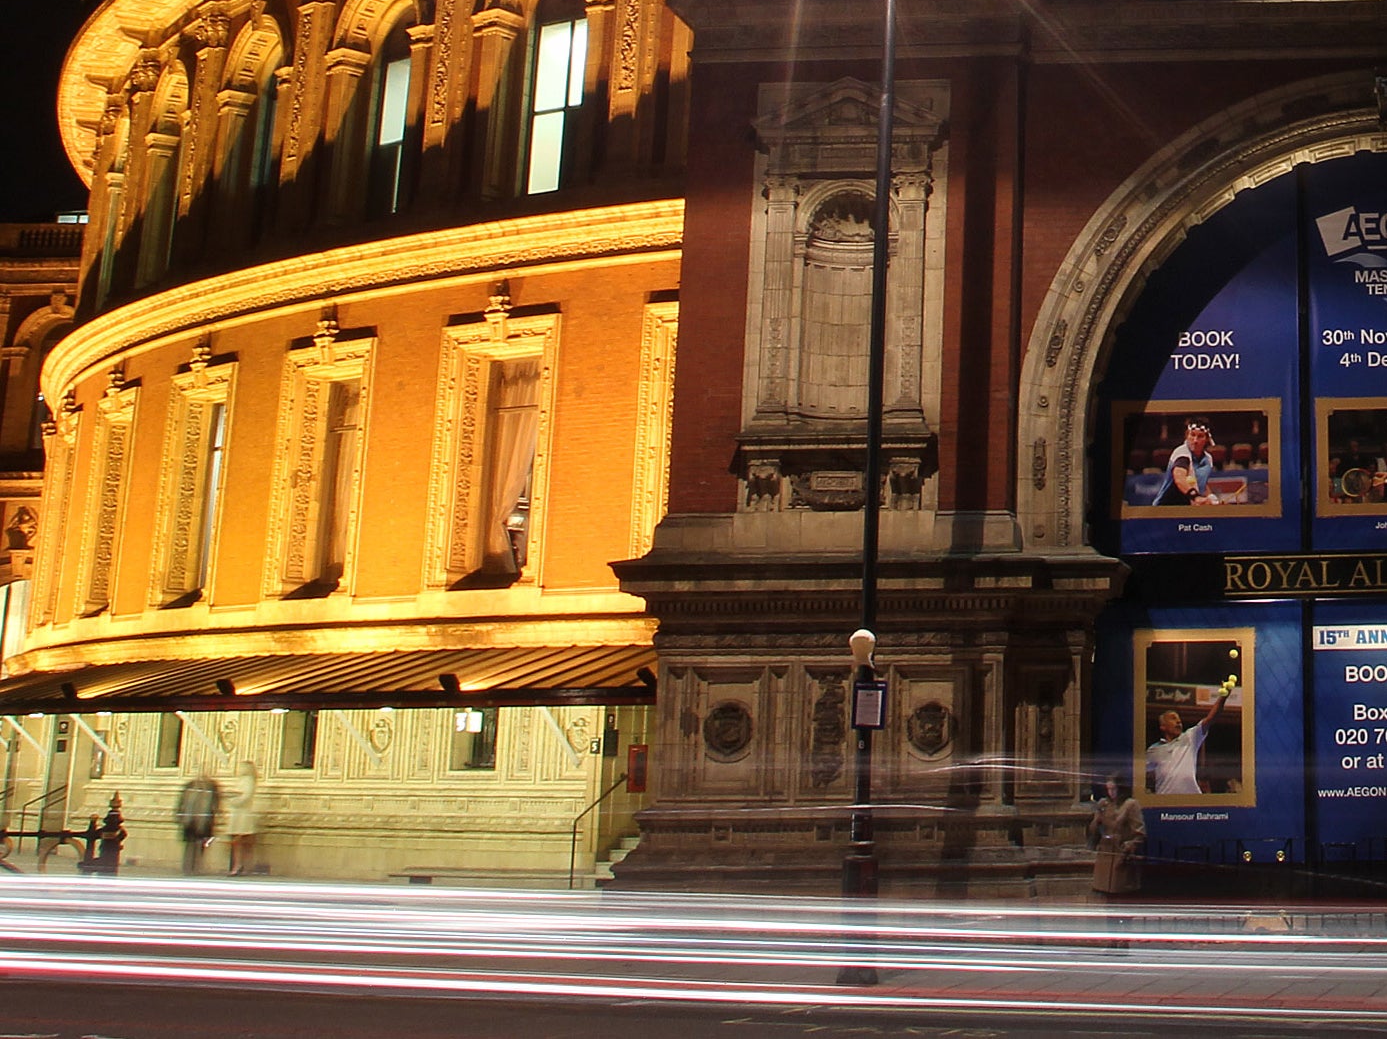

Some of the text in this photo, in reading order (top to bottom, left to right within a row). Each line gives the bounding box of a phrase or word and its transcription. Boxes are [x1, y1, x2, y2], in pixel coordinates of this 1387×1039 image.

[1178, 330, 1235, 347] BOOK
[1322, 329, 1355, 345] 30th
[1170, 354, 1240, 370] TODAY!
[1339, 352, 1362, 368] 4th
[1178, 524, 1213, 532] Pat Cash
[1224, 560, 1340, 591] ROYAL
[1319, 629, 1350, 645] 15TH
[1335, 728, 1369, 745] 020
[1341, 755, 1361, 769] or
[1366, 752, 1384, 769] at
[1161, 812, 1229, 821] Mansour Bahrami
